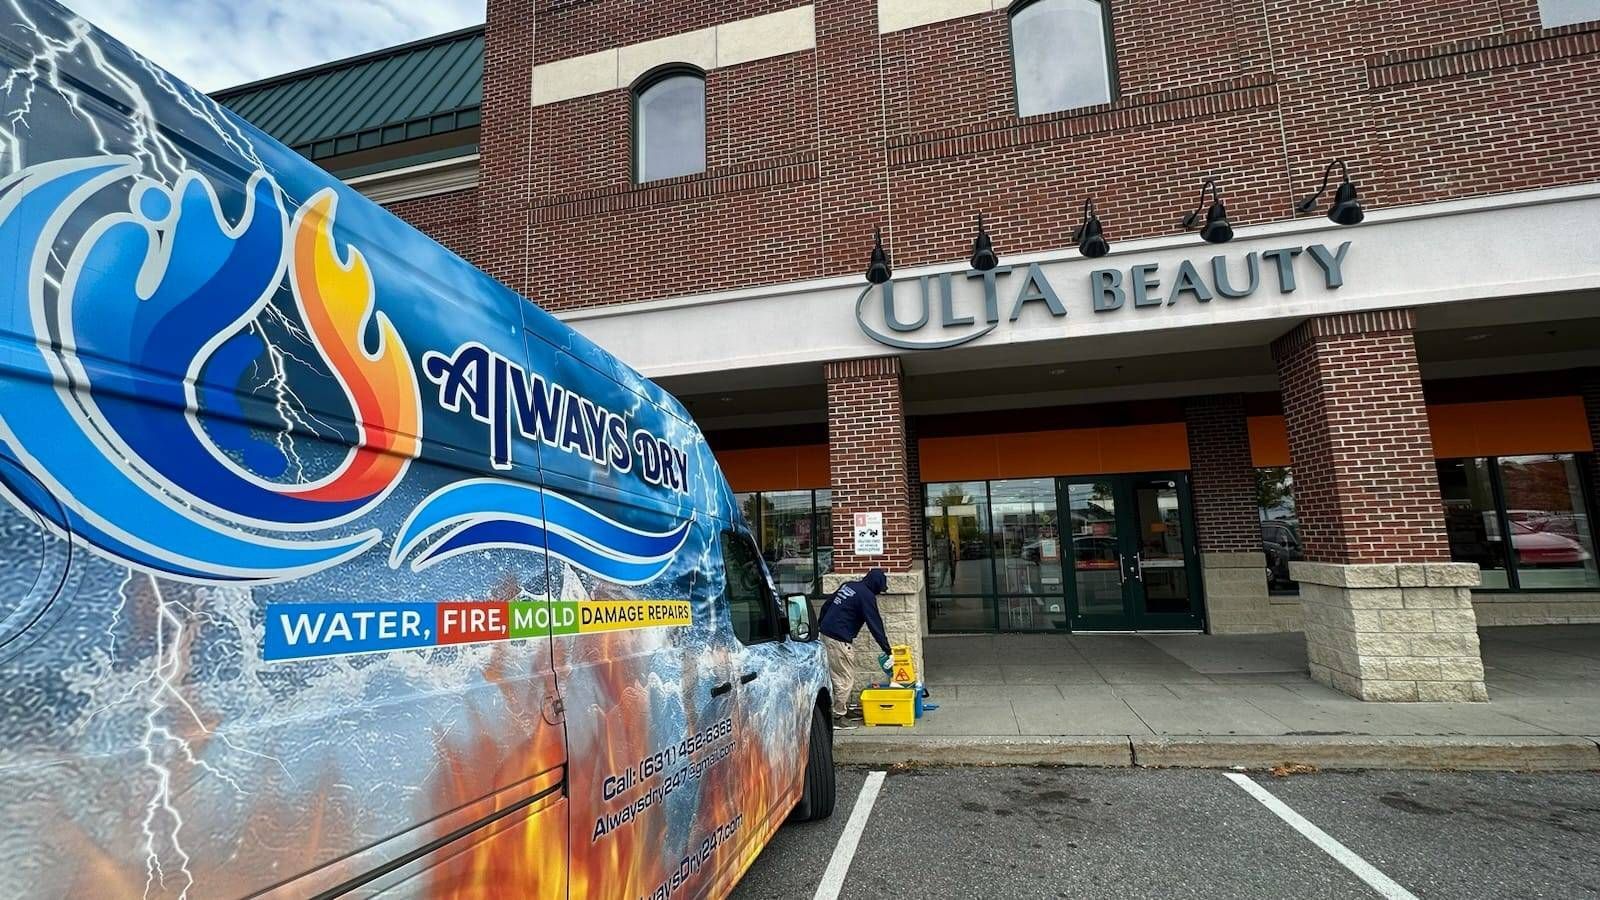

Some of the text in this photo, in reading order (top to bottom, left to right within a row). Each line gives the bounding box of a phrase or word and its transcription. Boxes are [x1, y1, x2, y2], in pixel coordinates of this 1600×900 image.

[882, 241, 1352, 332] ULTA BEAUTY
[634, 430, 689, 496] DRY
[280, 605, 689, 646] WATER, FIRE, MOLD DAMAGE REPAIRS
[604, 767, 636, 801] Call:
[639, 746, 676, 782] (631)
